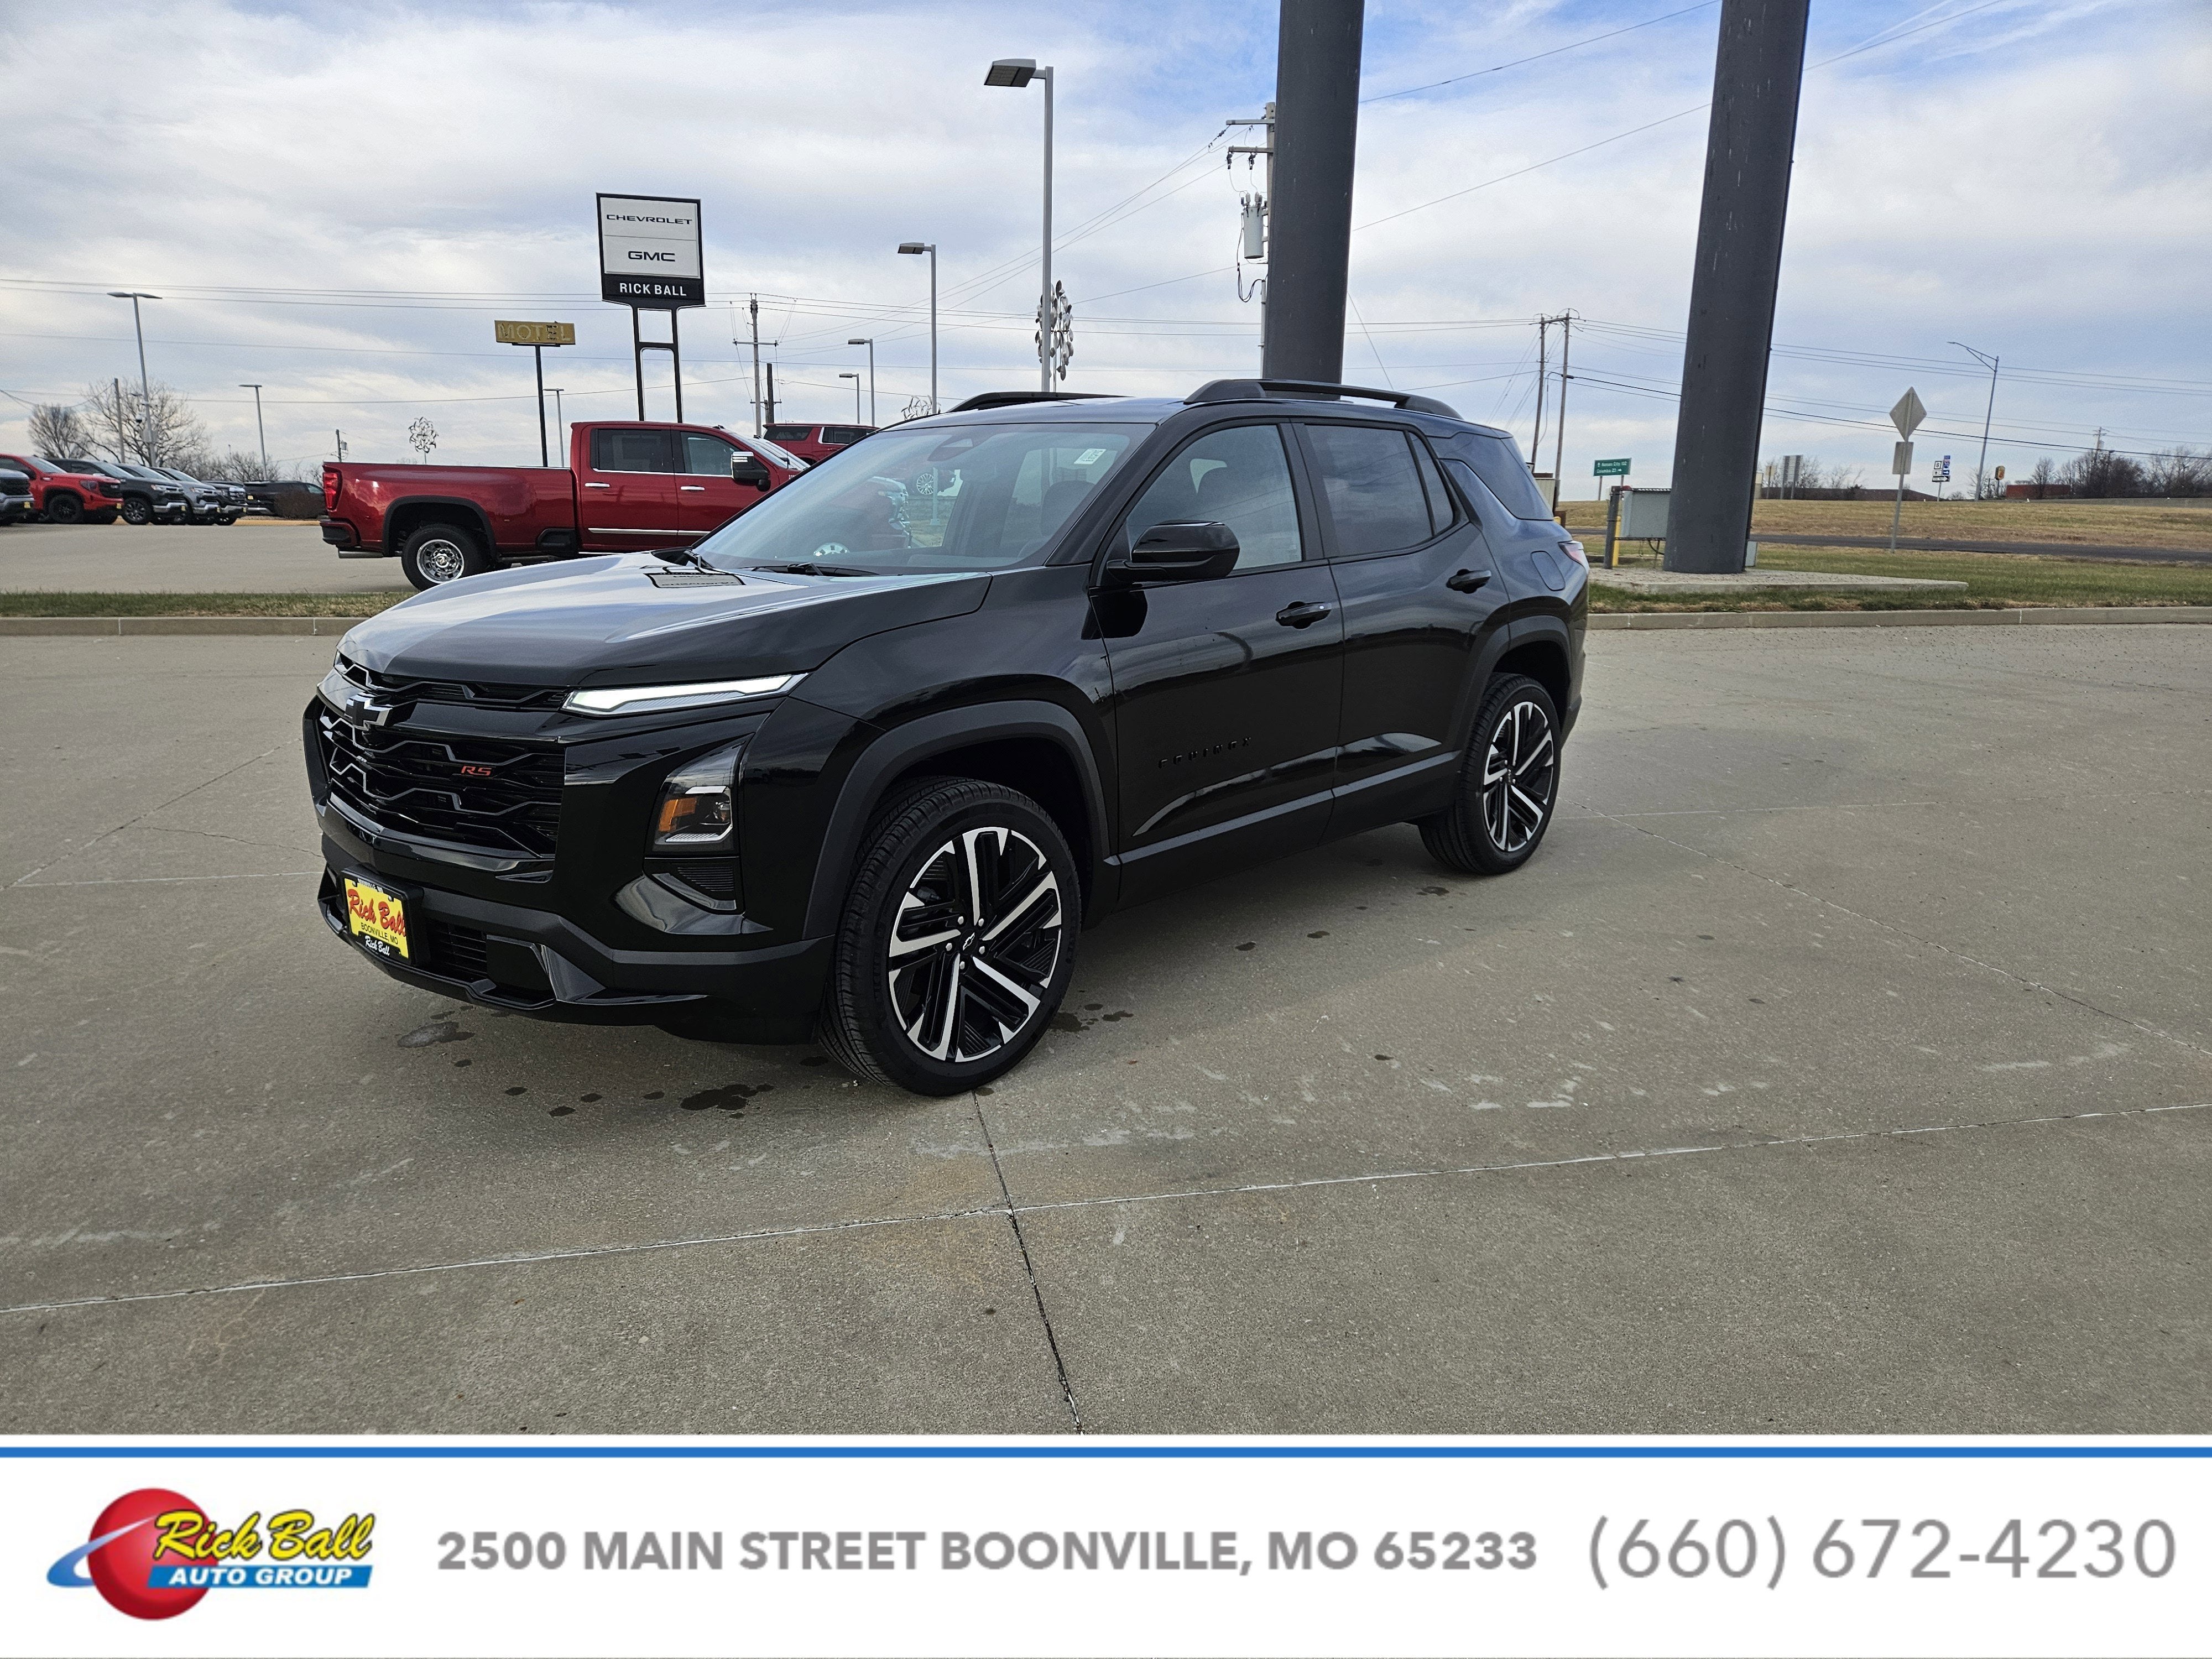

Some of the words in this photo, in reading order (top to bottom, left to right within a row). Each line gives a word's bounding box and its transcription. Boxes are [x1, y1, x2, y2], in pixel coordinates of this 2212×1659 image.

[606, 214, 692, 225] CHEVROLET
[628, 251, 676, 262] GMC
[619, 283, 651, 295] RICK
[654, 284, 687, 296] BALL
[498, 322, 572, 342] MOTEL
[461, 765, 492, 776] RS
[347, 888, 377, 925] Rick
[378, 901, 406, 937] Ball
[364, 935, 378, 951] Rick
[378, 941, 390, 957] Ball
[390, 935, 398, 945] MO
